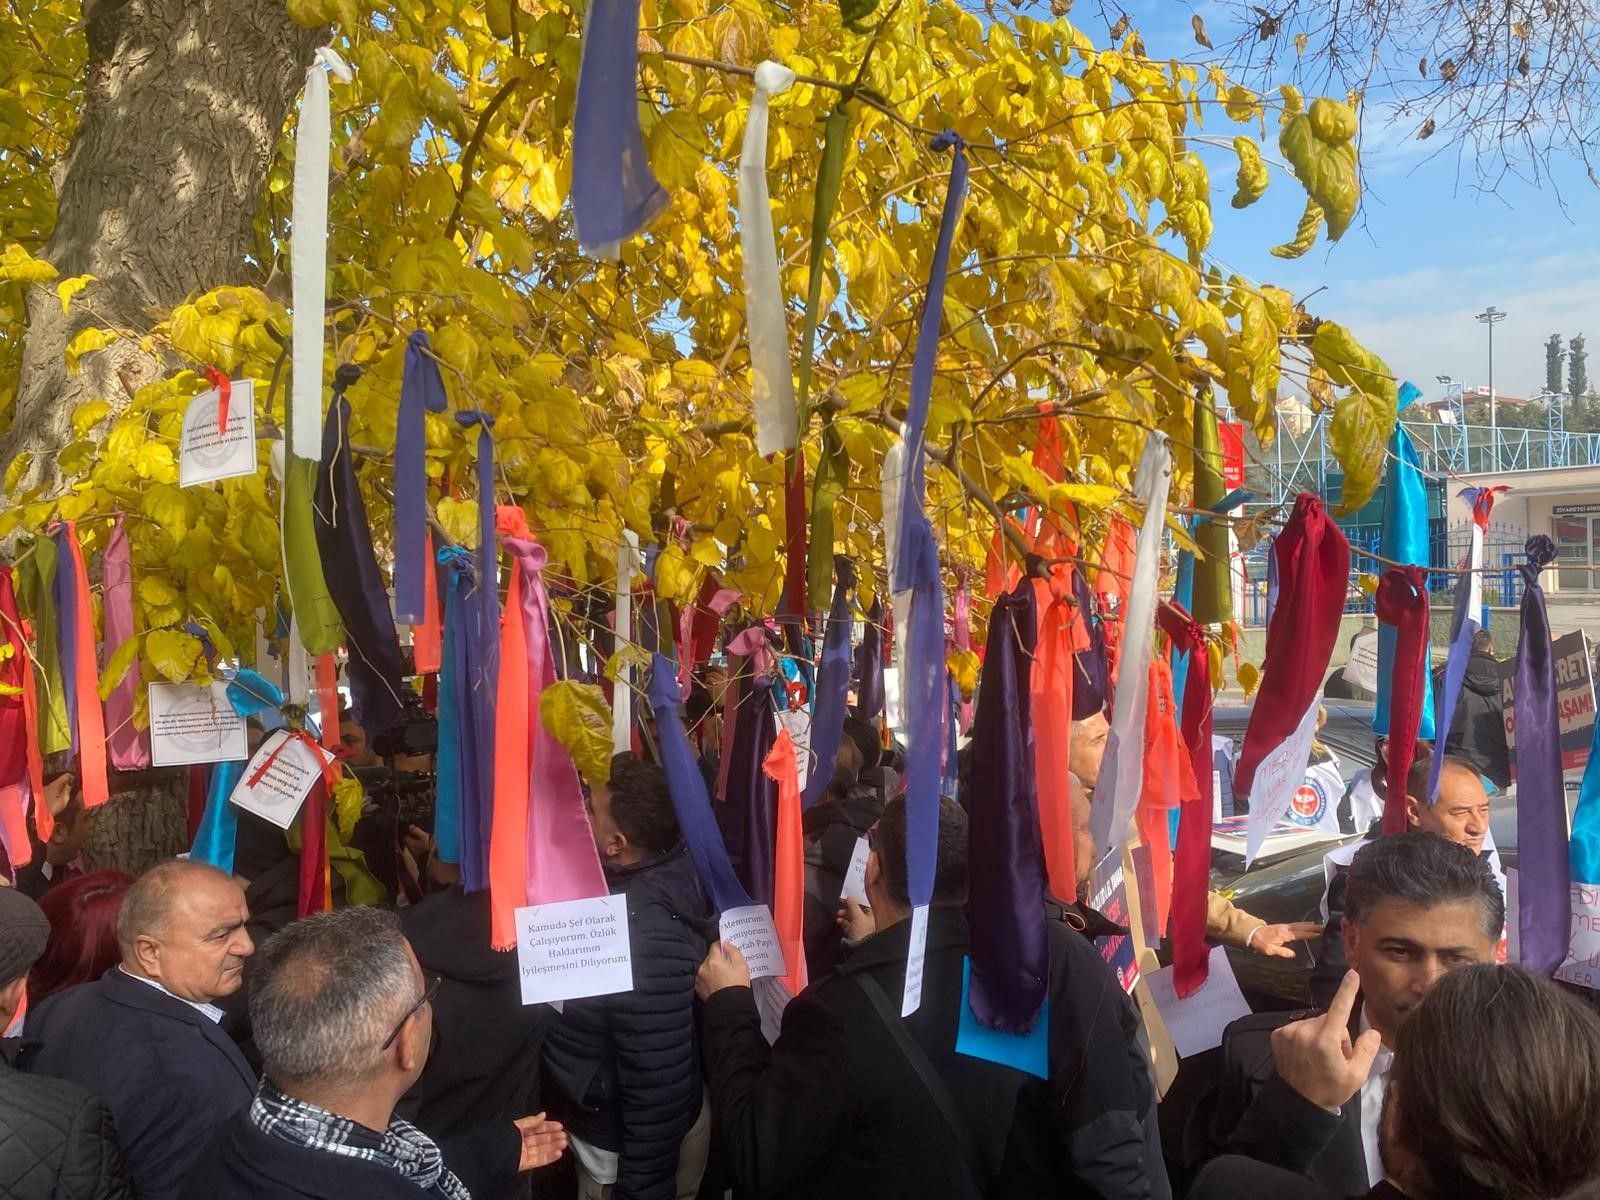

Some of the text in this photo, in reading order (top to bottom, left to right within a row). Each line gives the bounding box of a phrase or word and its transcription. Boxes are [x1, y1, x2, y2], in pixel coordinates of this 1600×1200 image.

[1559, 692, 1594, 723] AŞAM!
[528, 913, 617, 934] Kamuda Şef Olarak
[590, 927, 617, 939] Özlük
[548, 943, 601, 959] Haklarımın
[738, 940, 755, 952] efah
